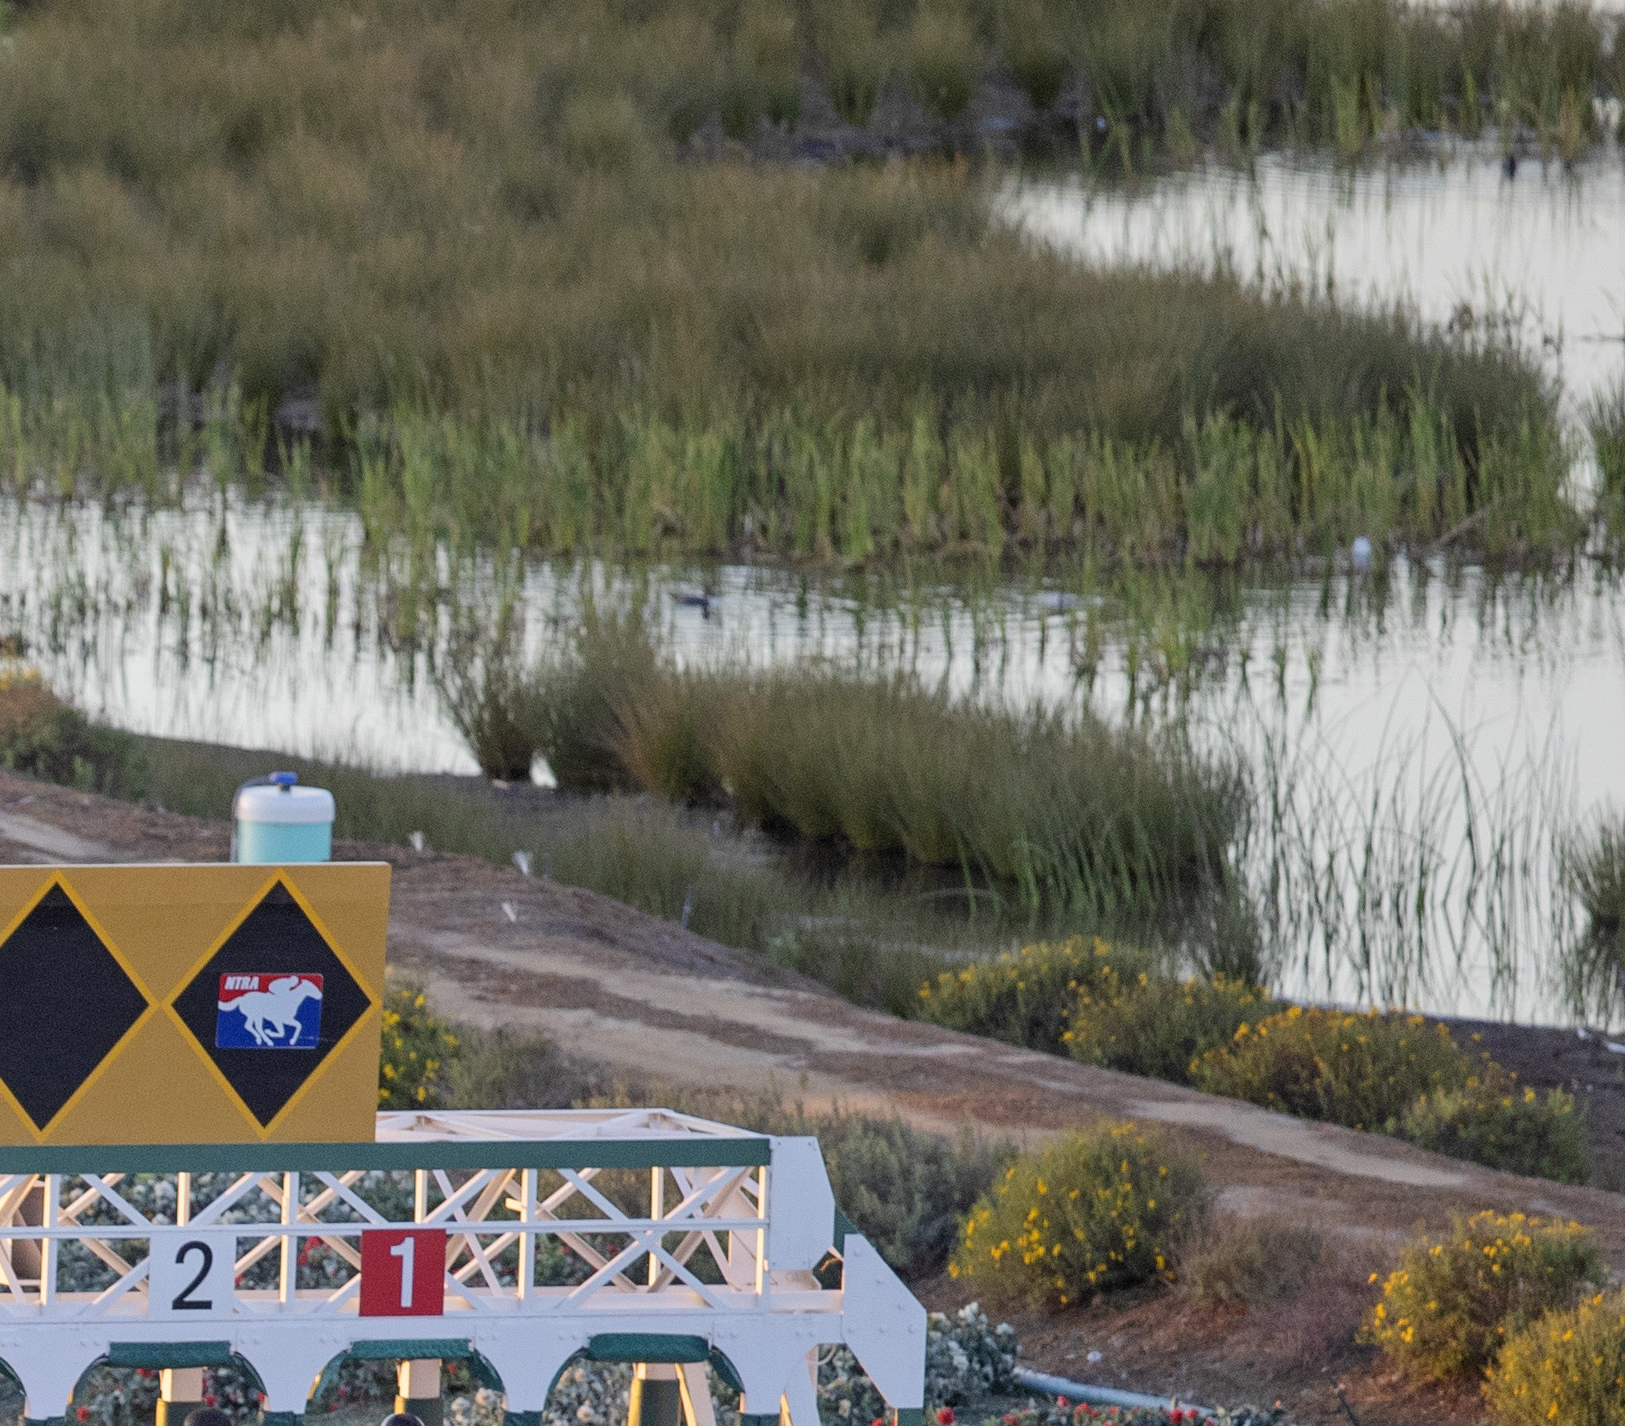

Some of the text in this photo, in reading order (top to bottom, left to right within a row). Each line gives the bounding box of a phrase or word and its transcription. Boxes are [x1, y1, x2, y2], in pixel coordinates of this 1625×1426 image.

[224, 976, 260, 990] NTRA
[171, 1240, 213, 1311] 2
[390, 1236, 415, 1308] 1
